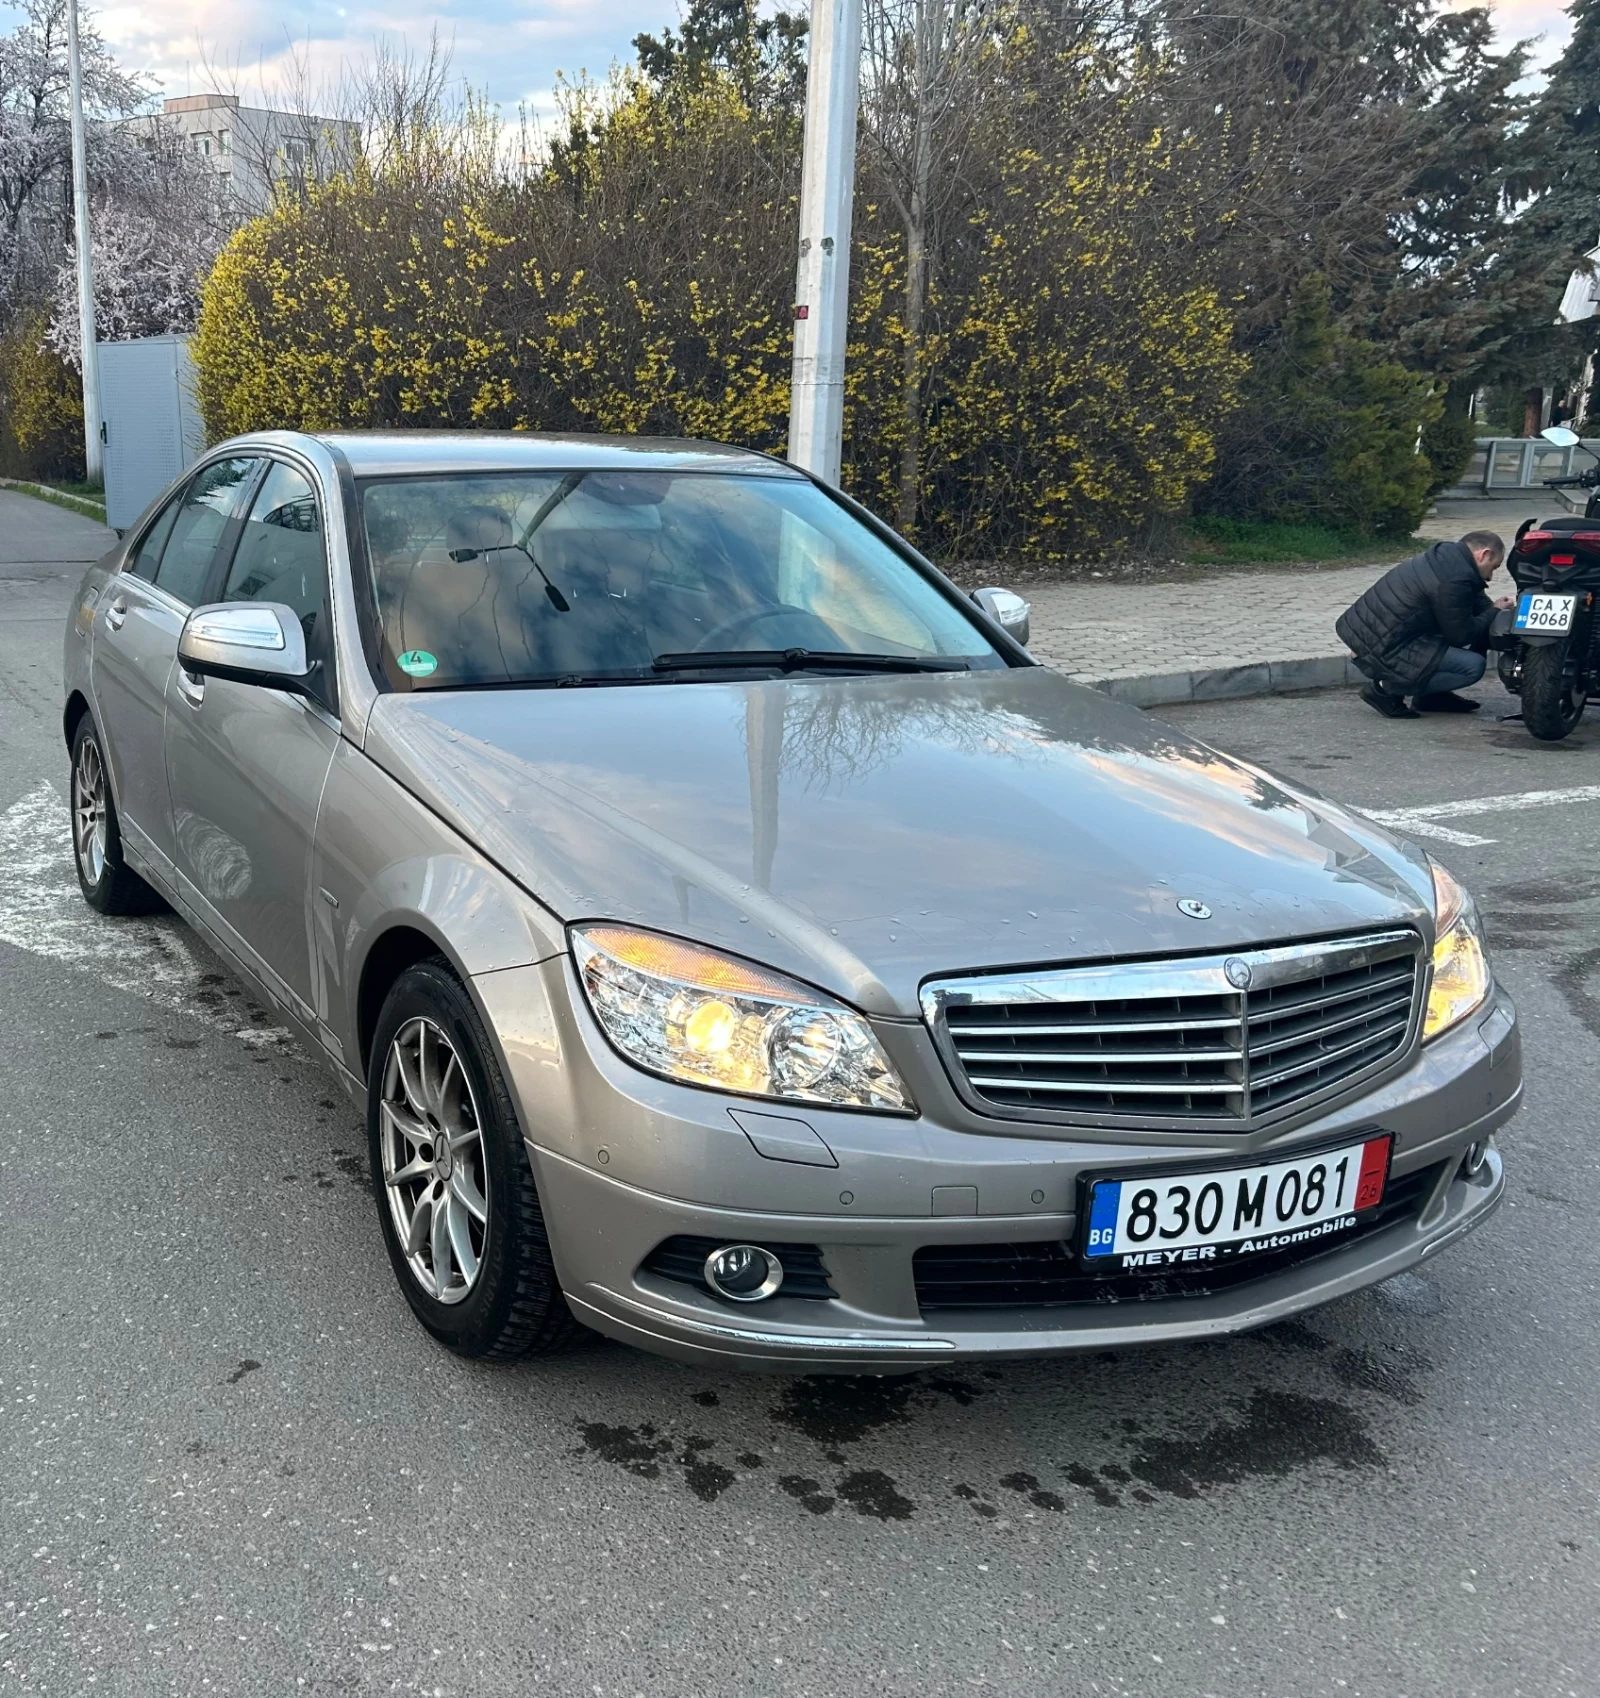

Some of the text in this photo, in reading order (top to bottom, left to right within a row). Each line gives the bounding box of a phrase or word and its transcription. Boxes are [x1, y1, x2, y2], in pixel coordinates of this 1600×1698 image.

[1532, 598, 1572, 612] CA X
[1529, 612, 1568, 626] 9068
[410, 651, 423, 664] 4
[1126, 1156, 1349, 1242] 830 M 081
[1089, 1227, 1113, 1246] BG
[1121, 1245, 1217, 1268] MEYER
[1238, 1214, 1358, 1254] Automobile
